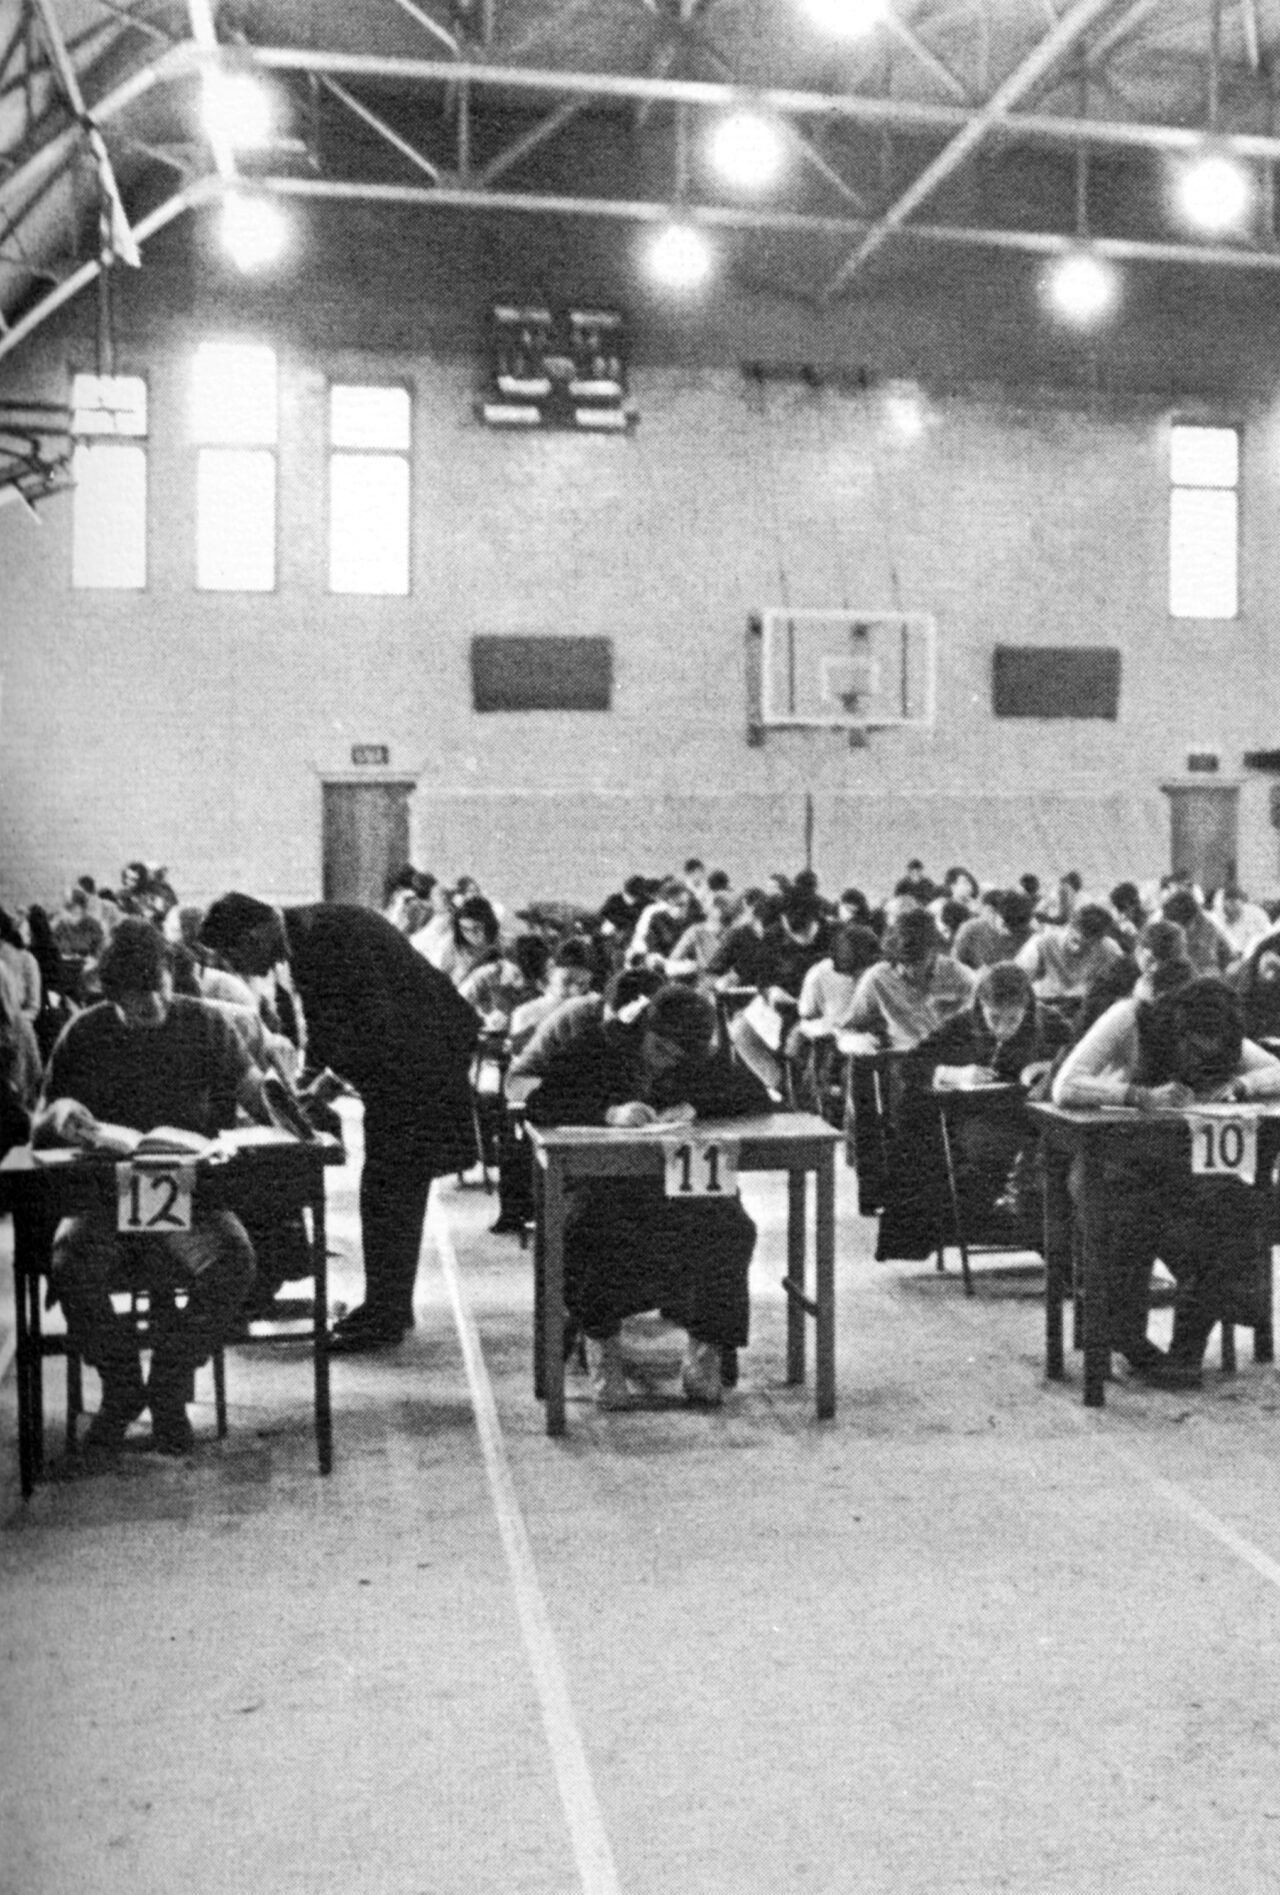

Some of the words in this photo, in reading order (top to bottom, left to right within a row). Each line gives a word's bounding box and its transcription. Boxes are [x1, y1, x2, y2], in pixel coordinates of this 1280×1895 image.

[674, 1143, 722, 1192] 11
[1201, 1123, 1245, 1168] 10
[127, 1174, 187, 1227] 12
